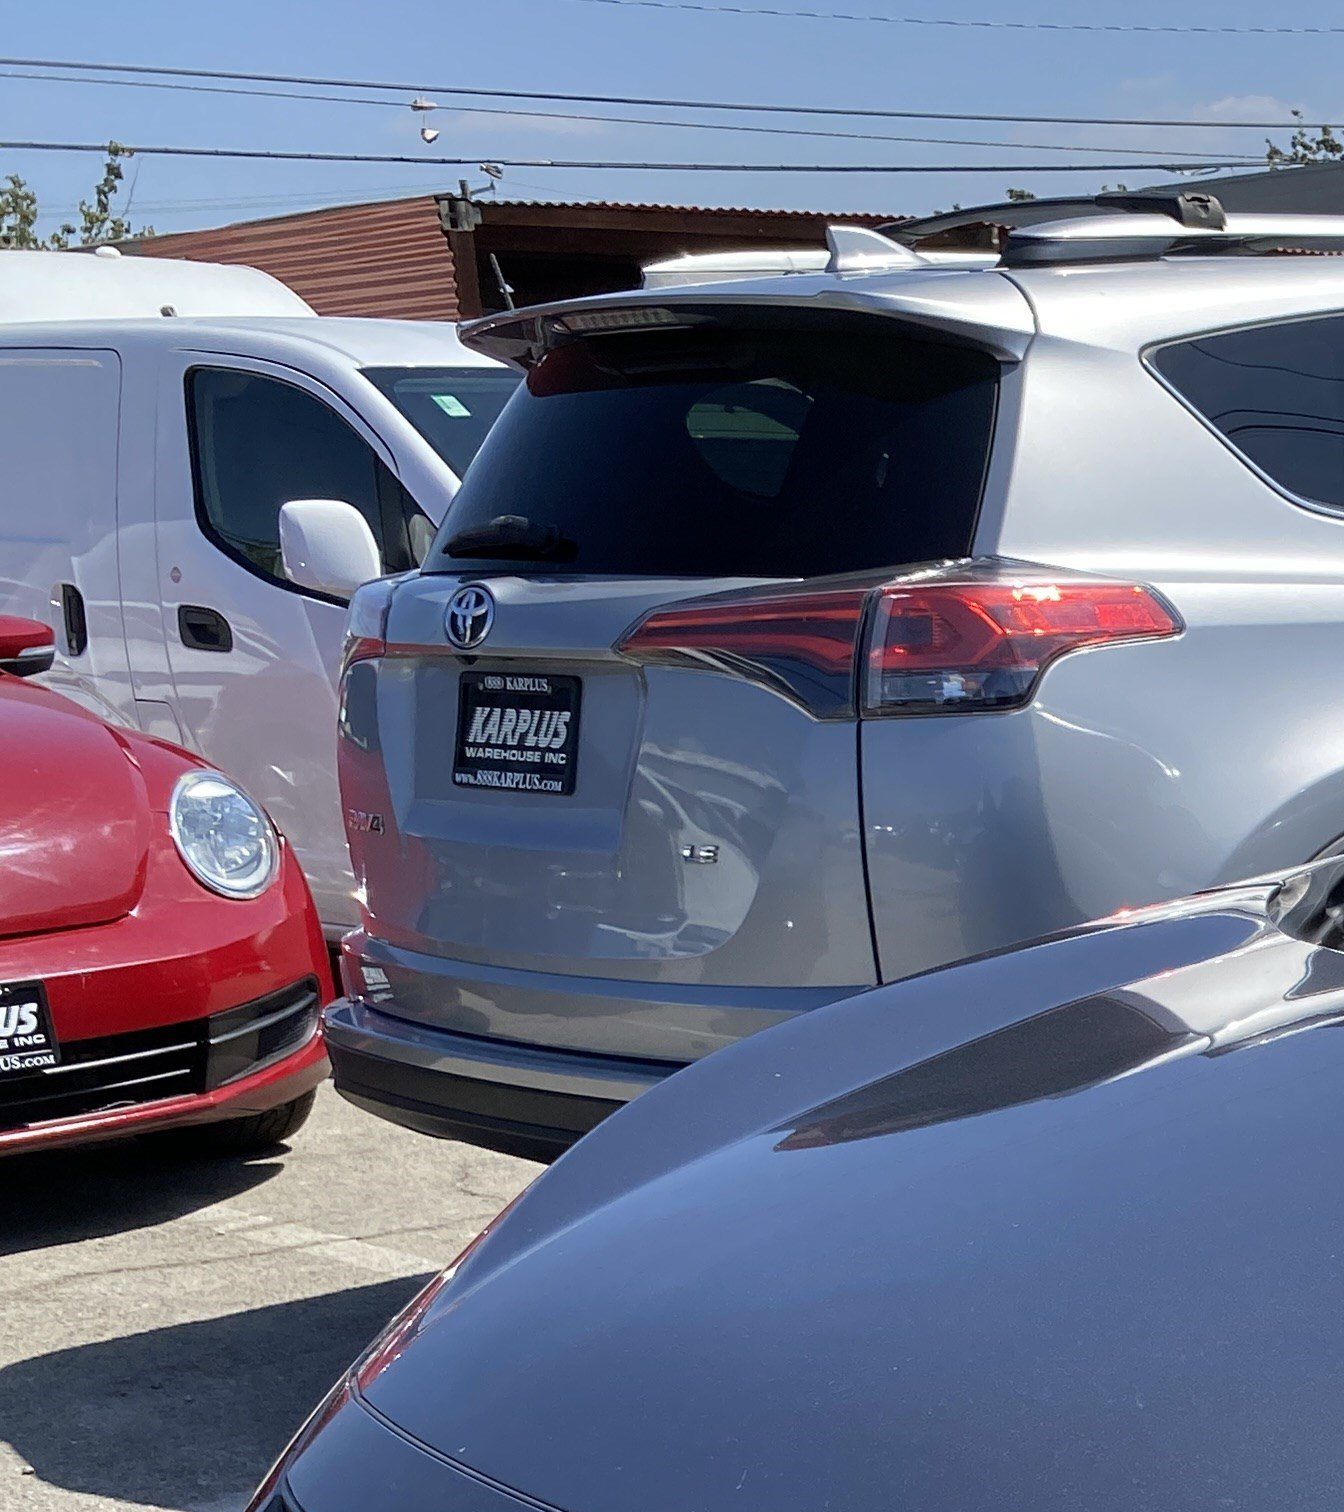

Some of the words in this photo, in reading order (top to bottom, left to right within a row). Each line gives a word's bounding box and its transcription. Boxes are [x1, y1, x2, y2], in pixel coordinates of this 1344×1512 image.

[506, 677, 548, 692] KARPLUS
[467, 706, 572, 749] KARPLUS
[465, 747, 542, 763] WAREHOUSE
[545, 752, 568, 765] INC
[14, 1033, 46, 1047] INC
